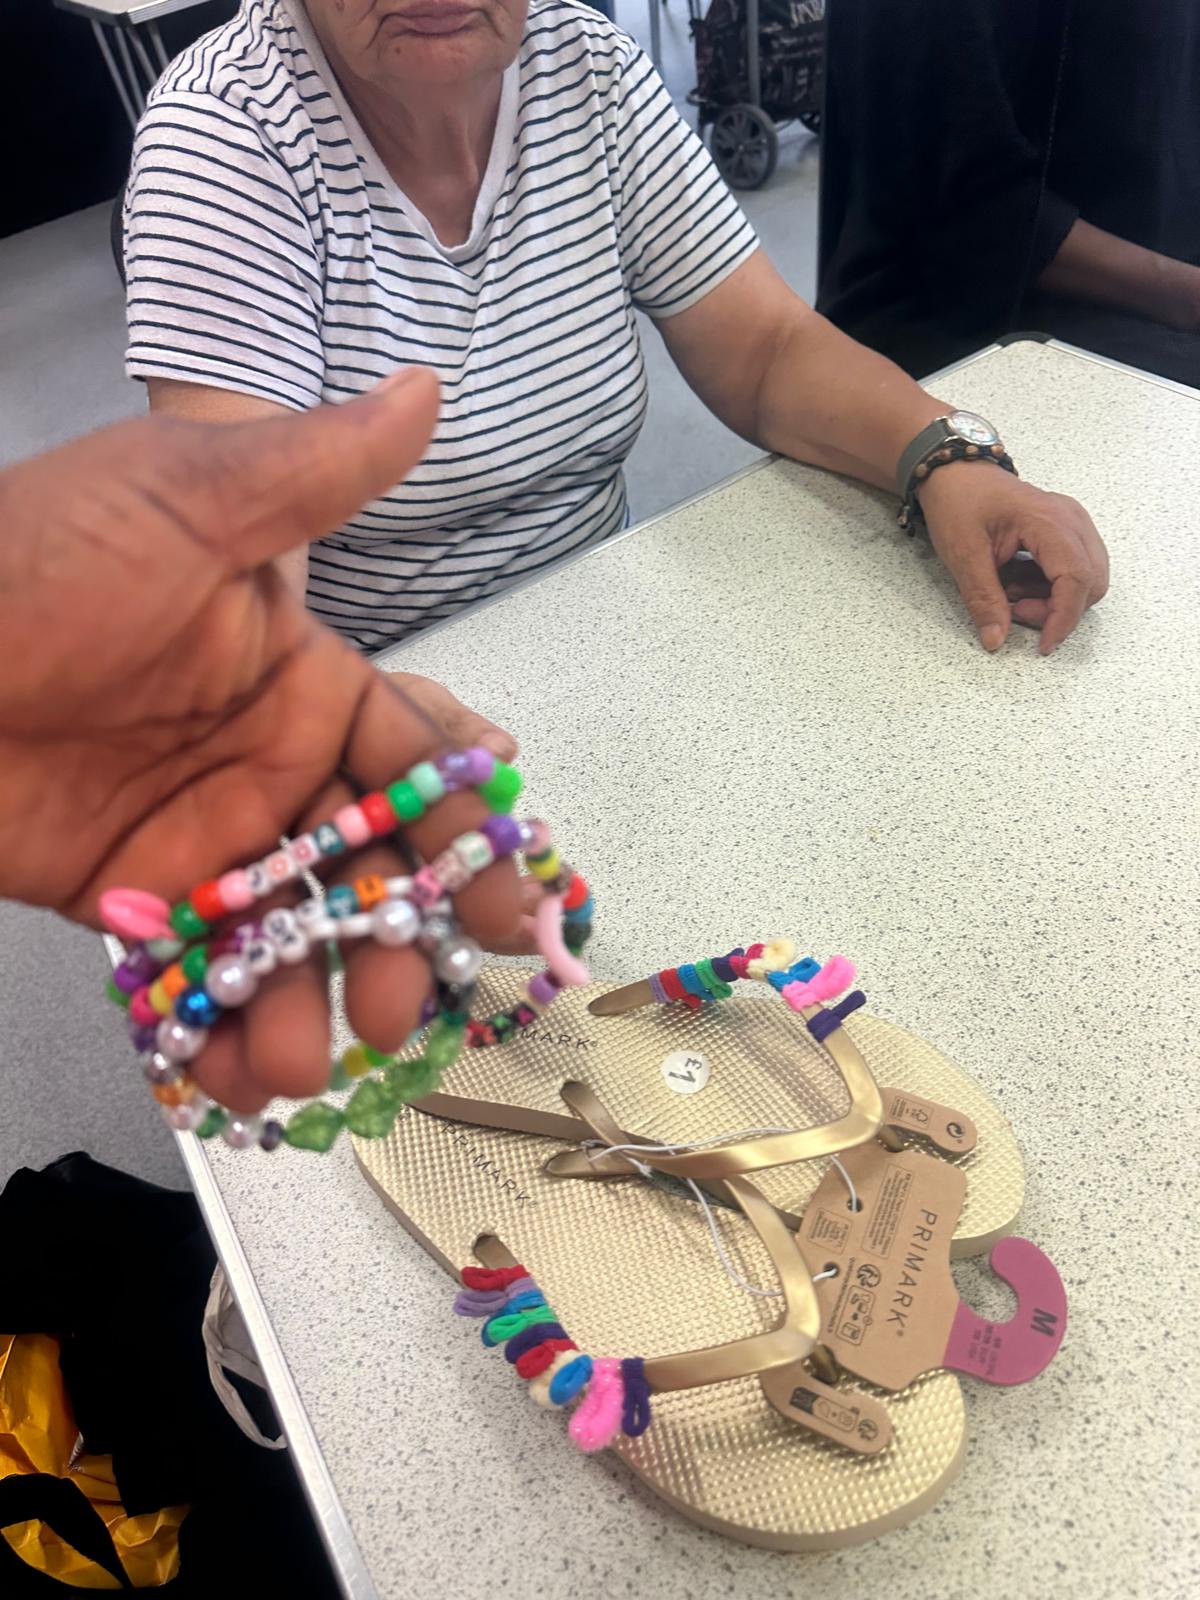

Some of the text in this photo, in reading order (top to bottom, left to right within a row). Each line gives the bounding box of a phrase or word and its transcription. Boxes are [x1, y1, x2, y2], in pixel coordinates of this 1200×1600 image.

[521, 1027, 591, 1050] MARK
[668, 1057, 702, 1082] £1
[887, 1208, 938, 1327] PRIMARK
[1030, 1307, 1058, 1338] M
